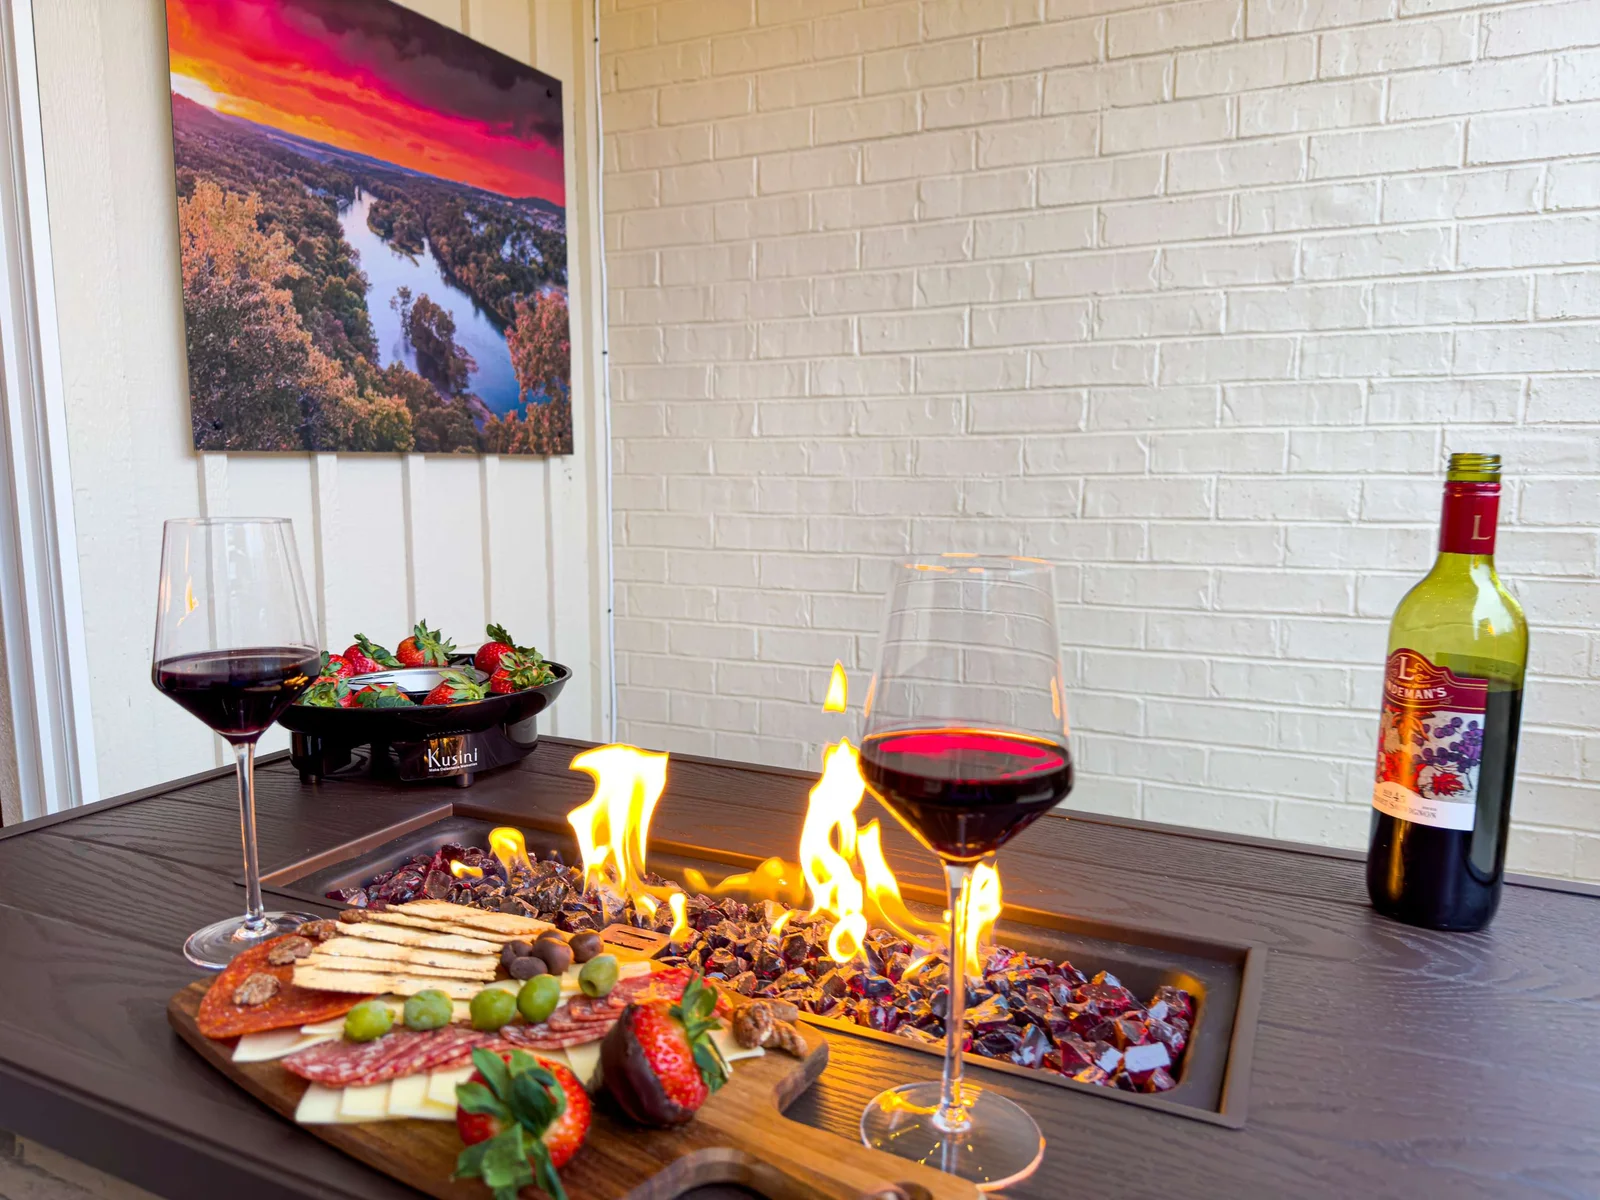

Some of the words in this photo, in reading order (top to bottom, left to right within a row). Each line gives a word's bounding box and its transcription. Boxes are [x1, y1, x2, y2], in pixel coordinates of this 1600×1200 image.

[1471, 514, 1492, 540] L
[1397, 656, 1415, 681] L
[427, 747, 478, 768] Kusini
